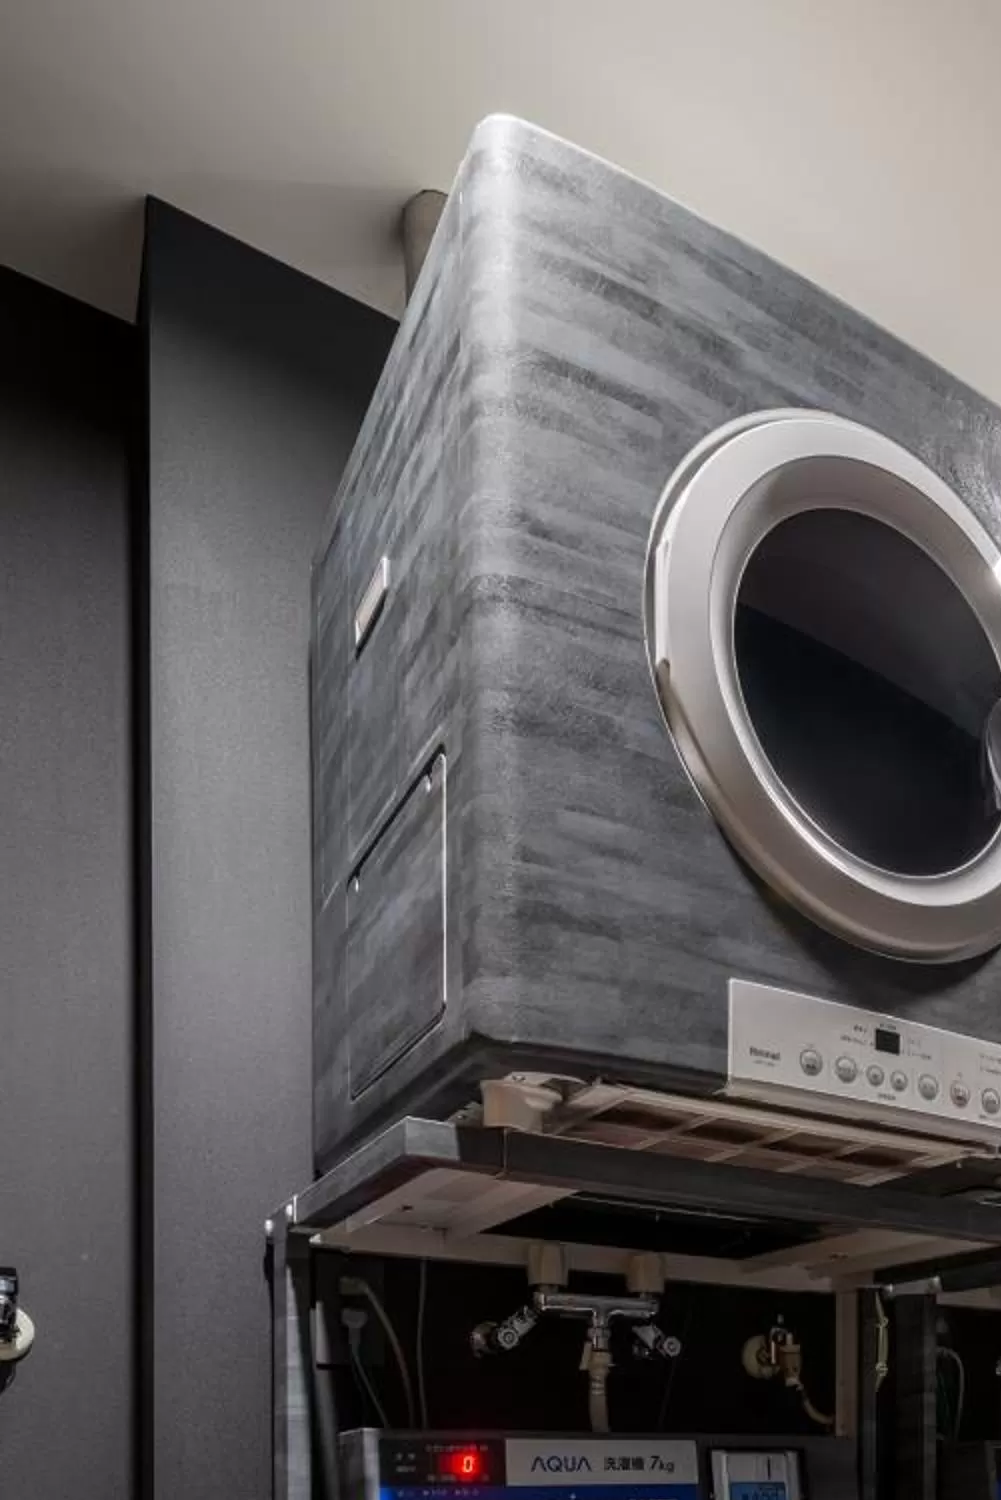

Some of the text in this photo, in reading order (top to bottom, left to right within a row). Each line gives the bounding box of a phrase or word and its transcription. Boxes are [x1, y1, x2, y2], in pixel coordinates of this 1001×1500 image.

[463, 1455, 474, 1473] 0
[530, 1455, 675, 1473] AQUA 洗濯機 7kg
